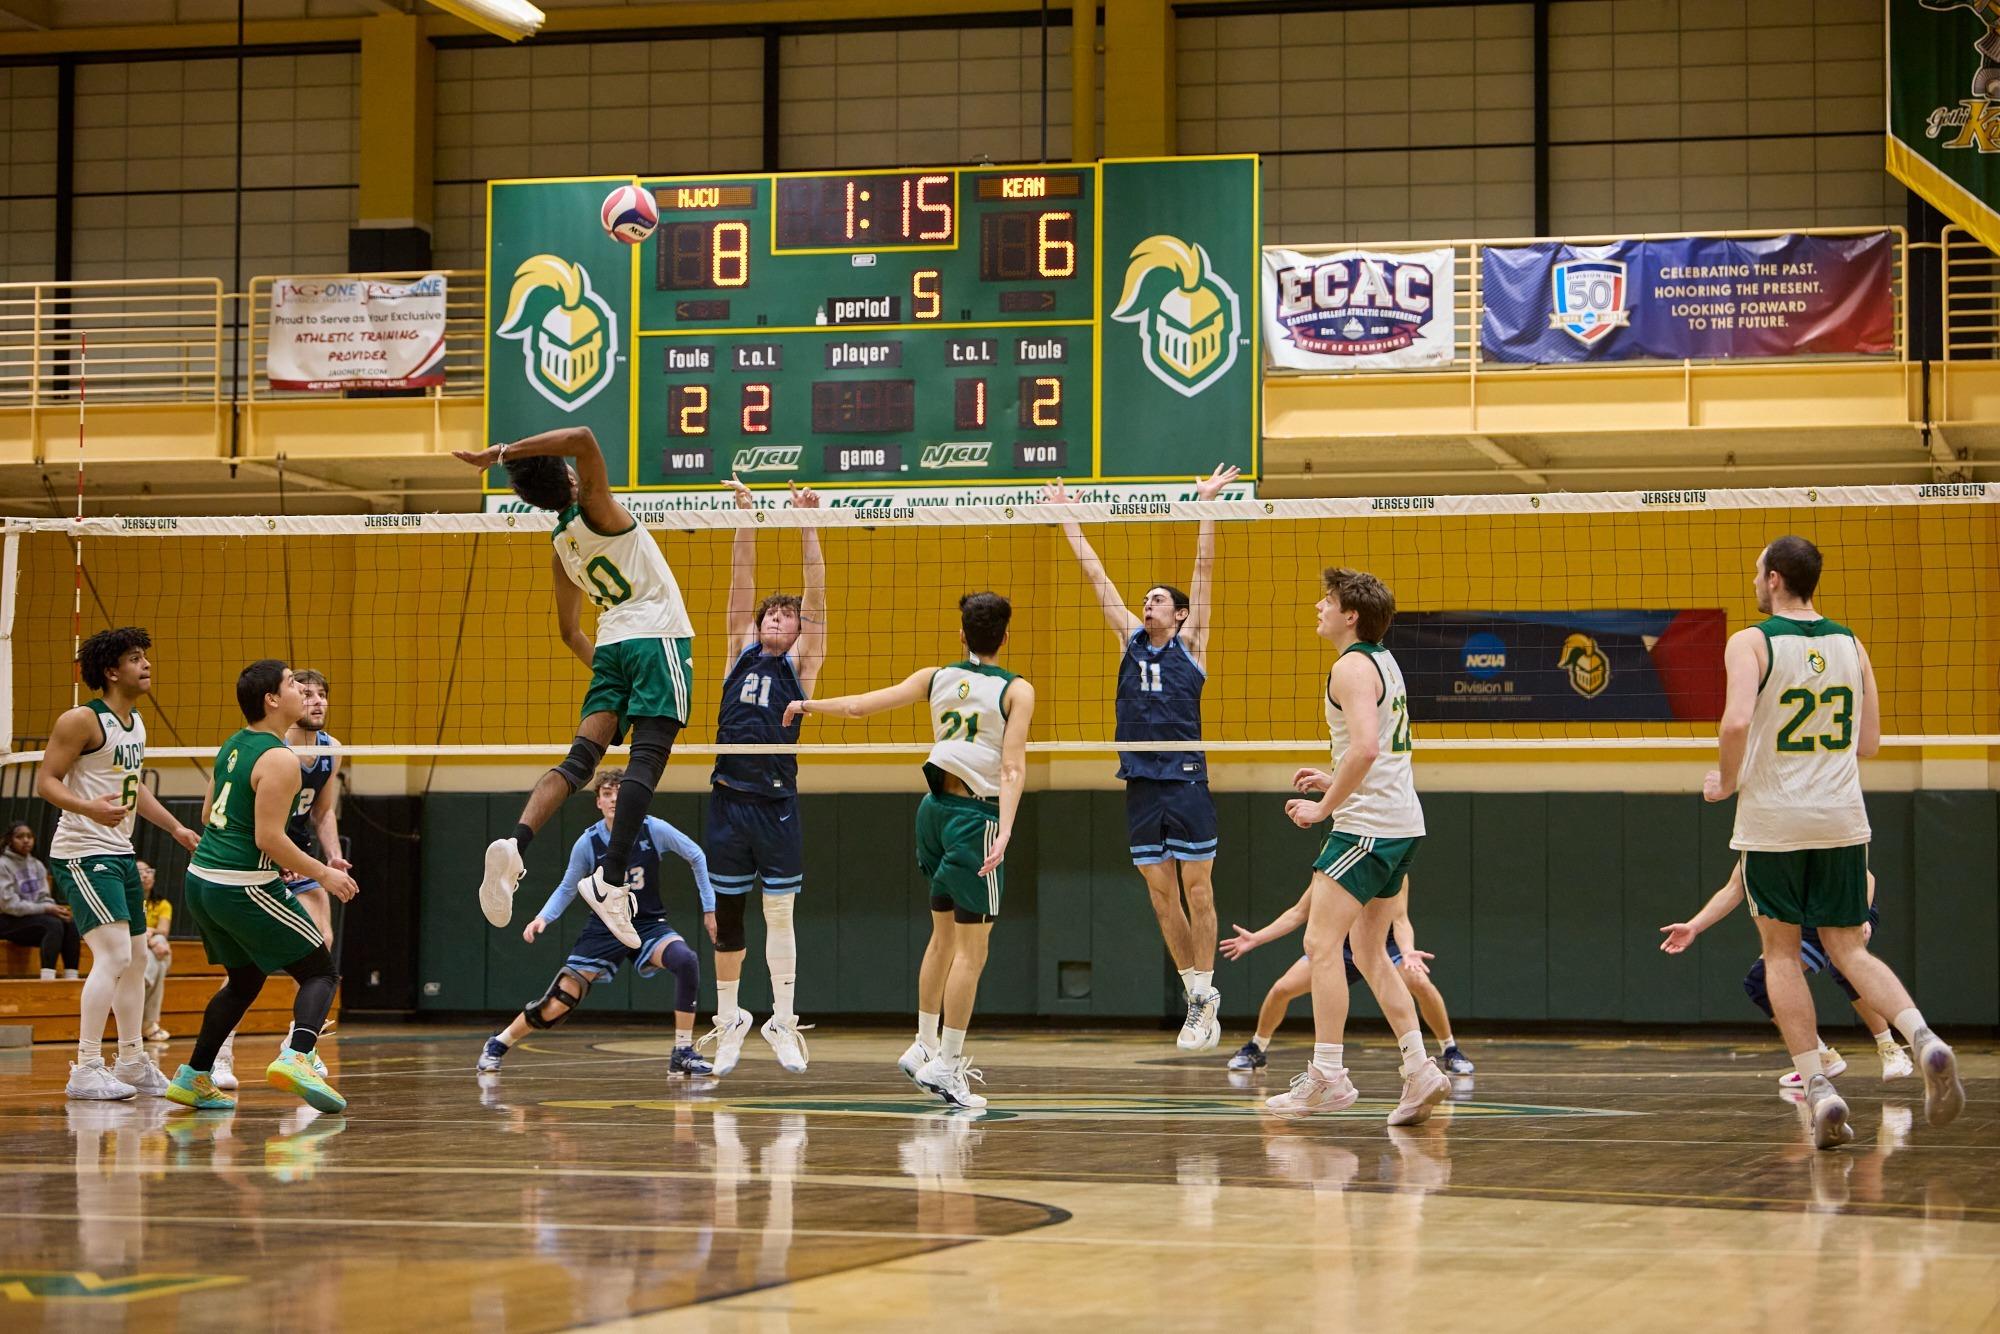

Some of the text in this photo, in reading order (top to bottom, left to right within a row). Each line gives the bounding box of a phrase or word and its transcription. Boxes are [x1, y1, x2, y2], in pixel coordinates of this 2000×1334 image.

[1002, 176, 1045, 198] KEAN
[678, 188, 720, 208] NJCU
[846, 175, 951, 240] 1:15
[713, 222, 748, 286] 8
[1039, 212, 1074, 277] 6
[1660, 263, 1817, 280] CELEBRATING THE PAST.
[913, 270, 940, 318] 5
[1279, 261, 1431, 317] ECAC
[1568, 280, 1612, 310] 50
[1654, 281, 1823, 298] HONORING THE PRESENT.
[275, 316, 303, 325] Proud
[306, 316, 317, 324] to
[321, 315, 350, 324] Serve
[391, 311, 442, 322] Exclusive
[835, 297, 890, 323] period
[1671, 301, 1807, 317] LOOKING FORWARD
[1688, 315, 1789, 330] TO THE FUTURE.
[295, 330, 420, 344] ATHLETIC TRAINING
[328, 351, 387, 361] PROVIDER
[669, 349, 709, 368] fouls
[832, 344, 889, 367] player
[1020, 341, 1062, 360] fouls
[681, 386, 707, 433] 2
[744, 385, 770, 432] 2
[976, 382, 985, 425] 1
[1033, 378, 1060, 426] 2
[672, 454, 705, 469] won
[732, 446, 802, 469] NJCU
[840, 447, 885, 467] game
[920, 443, 992, 467] NJCU
[1023, 444, 1056, 462] won
[1642, 491, 1706, 504] JERSEY CITY
[1919, 484, 1985, 498] JERSEY CITY
[855, 508, 914, 519] JERSEY CITY
[1110, 503, 1171, 515] JERSEY CITY
[1372, 497, 1434, 510] JERSEY CITY
[122, 518, 177, 529] JERSEY CITY
[365, 514, 422, 527] JERSEY CITY
[645, 512, 664, 523] CITY
[1465, 654, 1505, 668] NCAA
[1138, 661, 1163, 692] 11
[740, 672, 772, 708] 21
[1454, 681, 1501, 694] Division
[940, 711, 979, 743] 21
[1777, 686, 1854, 753] 23
[121, 774, 138, 811] 6
[210, 782, 232, 830] 4
